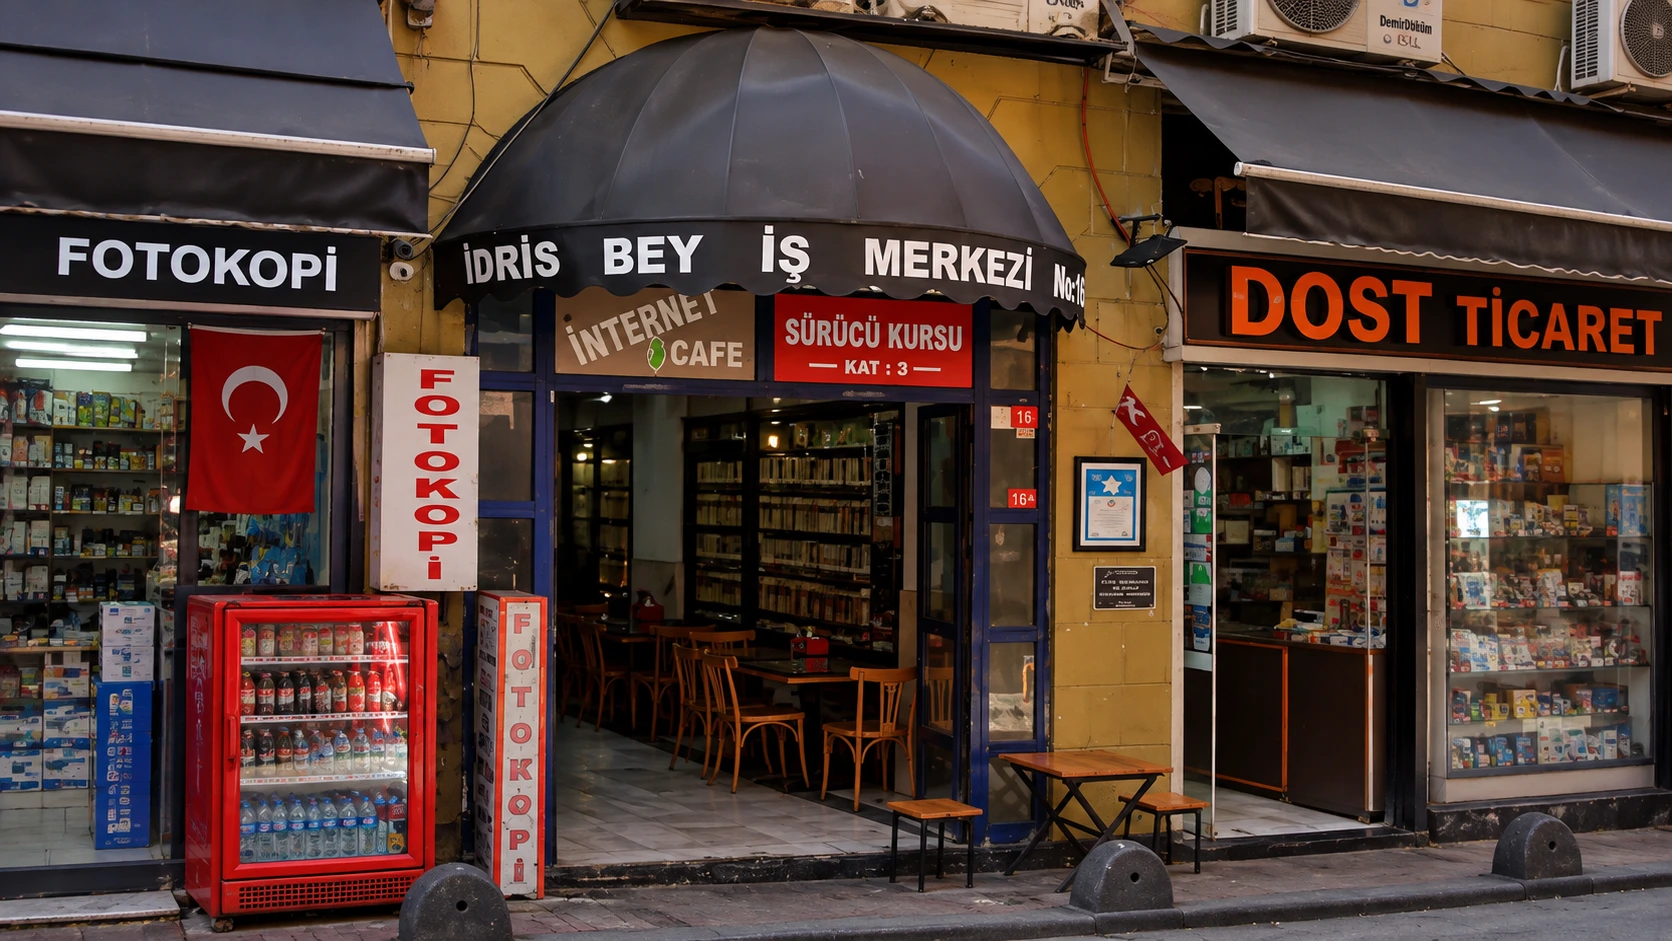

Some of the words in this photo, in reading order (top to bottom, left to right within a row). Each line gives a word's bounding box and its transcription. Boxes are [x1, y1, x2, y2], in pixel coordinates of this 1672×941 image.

[57, 236, 338, 292] FOTOKOPİ
[463, 234, 561, 285] İDRİS
[603, 234, 704, 276] BEY
[761, 225, 811, 284] İŞ
[865, 237, 1033, 291] MERKEZİ
[1053, 263, 1086, 308] No:16
[785, 312, 881, 349] SÜRÜCÜ
[888, 322, 963, 352] KURSU
[1230, 265, 1433, 345] DOST
[1456, 286, 1663, 356] TİCARET
[670, 340, 744, 368] CAFE
[844, 359, 880, 375] KAT
[896, 361, 909, 376] 3
[1017, 409, 1032, 424] 16
[414, 368, 461, 580] FOTOKOPİ
[508, 613, 533, 883] FOTOKOPİ
